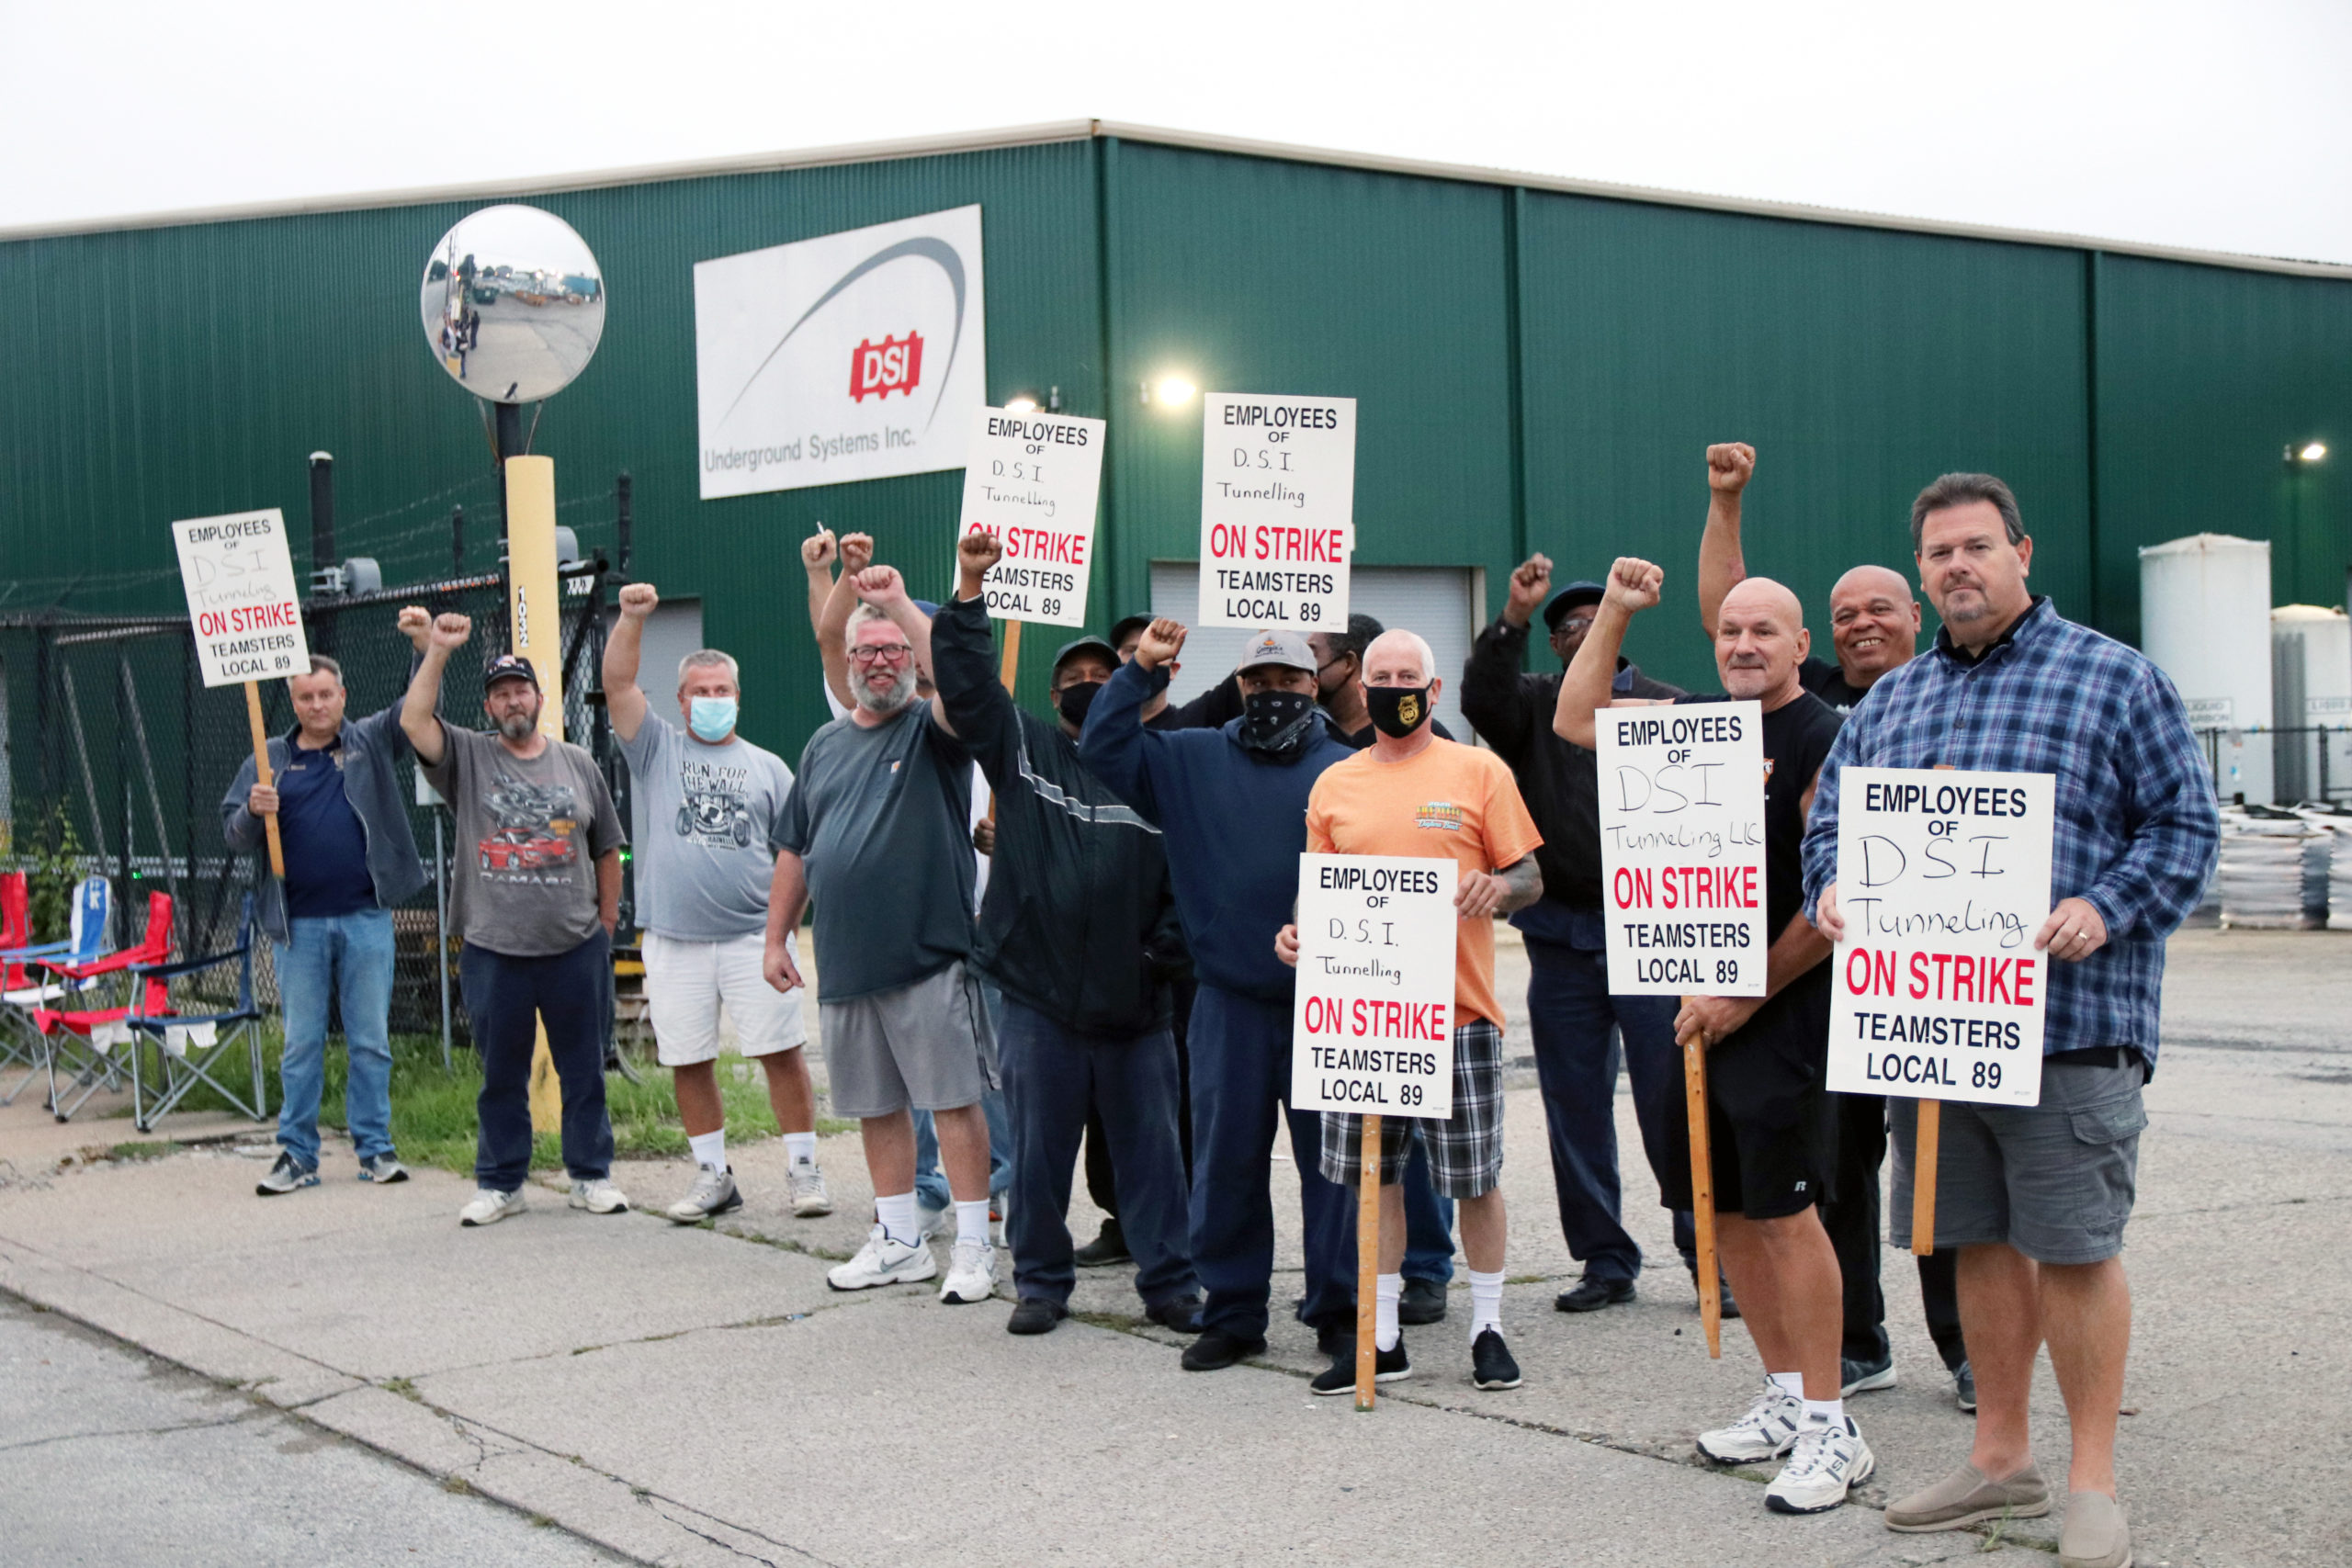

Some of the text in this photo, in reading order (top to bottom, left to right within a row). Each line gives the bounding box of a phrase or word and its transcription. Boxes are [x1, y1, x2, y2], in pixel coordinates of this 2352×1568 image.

[862, 344, 910, 389] DSI
[1224, 404, 1337, 430] EMPLOYEES
[988, 417, 1088, 446] EMPLOYEES
[1268, 432, 1290, 443] OF
[704, 426, 916, 472] Underground Systems Inc.
[1025, 445, 1046, 455] OF
[189, 519, 271, 543] EMPLOYEES
[1211, 524, 1343, 563] ON STRIKE
[224, 541, 240, 549] OF
[1007, 526, 1086, 565] STRIKE
[1217, 570, 1333, 593] TEAMSTERS
[985, 591, 1060, 615] OCAL 89
[1227, 599, 1321, 622] LOCAL 89
[199, 603, 296, 637] ON STRIKE
[518, 586, 529, 648] 1032
[209, 634, 295, 658] TEAMSTERS
[221, 656, 290, 676] LOCAL 89
[1618, 716, 1742, 746] EMPLOYEES
[1668, 750, 1690, 762] OF
[680, 773, 746, 794] THE WALL
[683, 761, 747, 779] RUN FOR
[1866, 784, 2027, 817] EMPLOYEES
[1606, 825, 1722, 858] Tunneling
[1928, 820, 1959, 836] OF
[1320, 867, 1438, 894] EMPLOYEES
[1614, 866, 1758, 909] ON STRIKE
[1367, 897, 1389, 908] OF
[1623, 923, 1750, 948] TEAMSTERS
[1848, 898, 2029, 948] Tunneling
[1638, 959, 1738, 984] LOCAL 89
[1847, 948, 2035, 1007] ON STRIKE
[1305, 996, 1446, 1041] ON STRIKE
[1854, 1012, 2021, 1050] TEAMSTERS
[1311, 1047, 1436, 1075] TEAMSTERS
[1867, 1053, 2001, 1089] LOCAL 89
[1321, 1078, 1422, 1106] LOCAL 89
